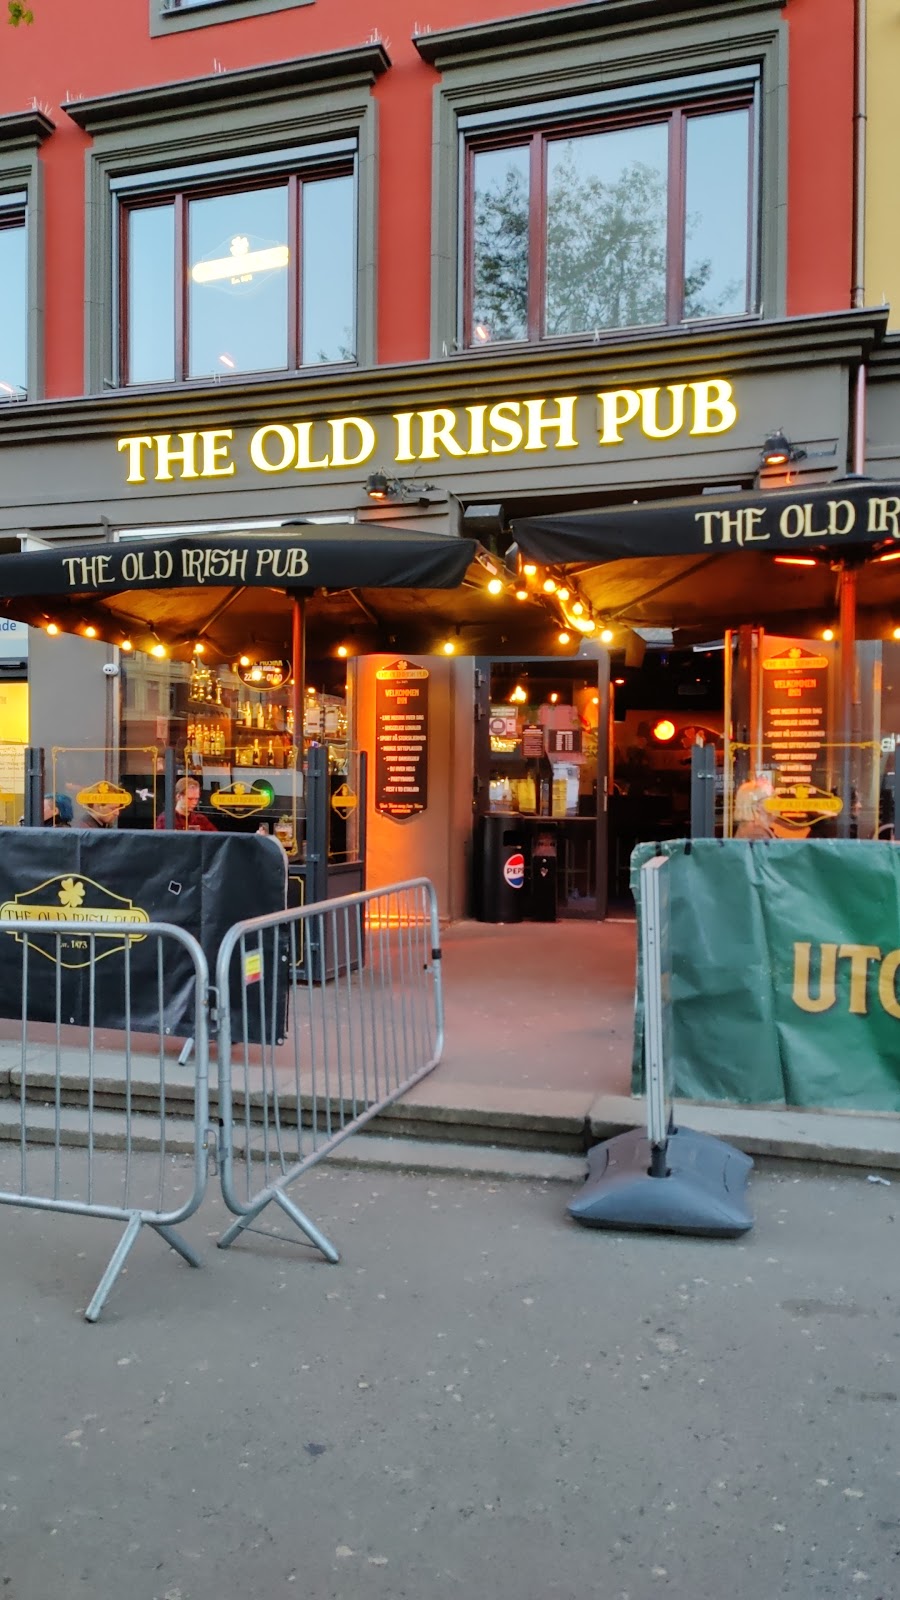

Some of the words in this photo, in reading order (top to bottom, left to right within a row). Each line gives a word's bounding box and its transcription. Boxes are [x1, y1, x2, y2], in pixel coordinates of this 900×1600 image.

[117, 429, 235, 482] THE
[250, 416, 377, 473] OLD
[394, 396, 579, 462] IRISH
[597, 378, 738, 446] PUB
[694, 506, 770, 547] THE
[779, 499, 856, 538] OLD
[62, 553, 115, 588] THE
[121, 549, 173, 582] OLD
[182, 548, 248, 584] IRISH
[256, 547, 309, 578] PUB
